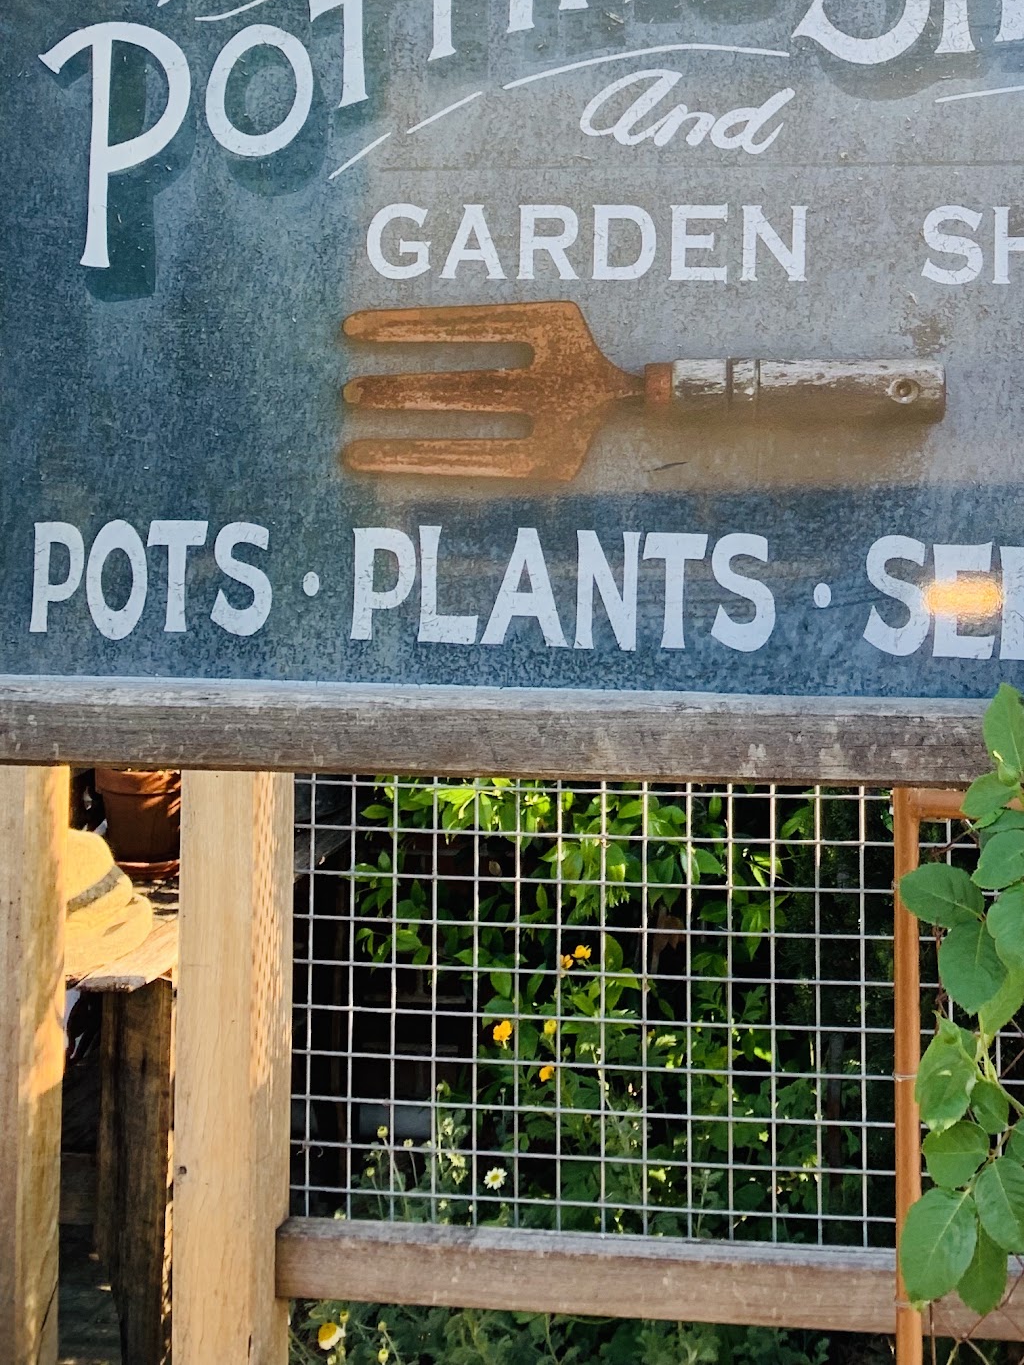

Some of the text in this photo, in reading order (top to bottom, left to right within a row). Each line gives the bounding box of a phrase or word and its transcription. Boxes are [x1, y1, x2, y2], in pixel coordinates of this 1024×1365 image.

[367, 203, 808, 283] GARDEN
[29, 519, 273, 640] POTS
[350, 525, 776, 652] PLANTS
